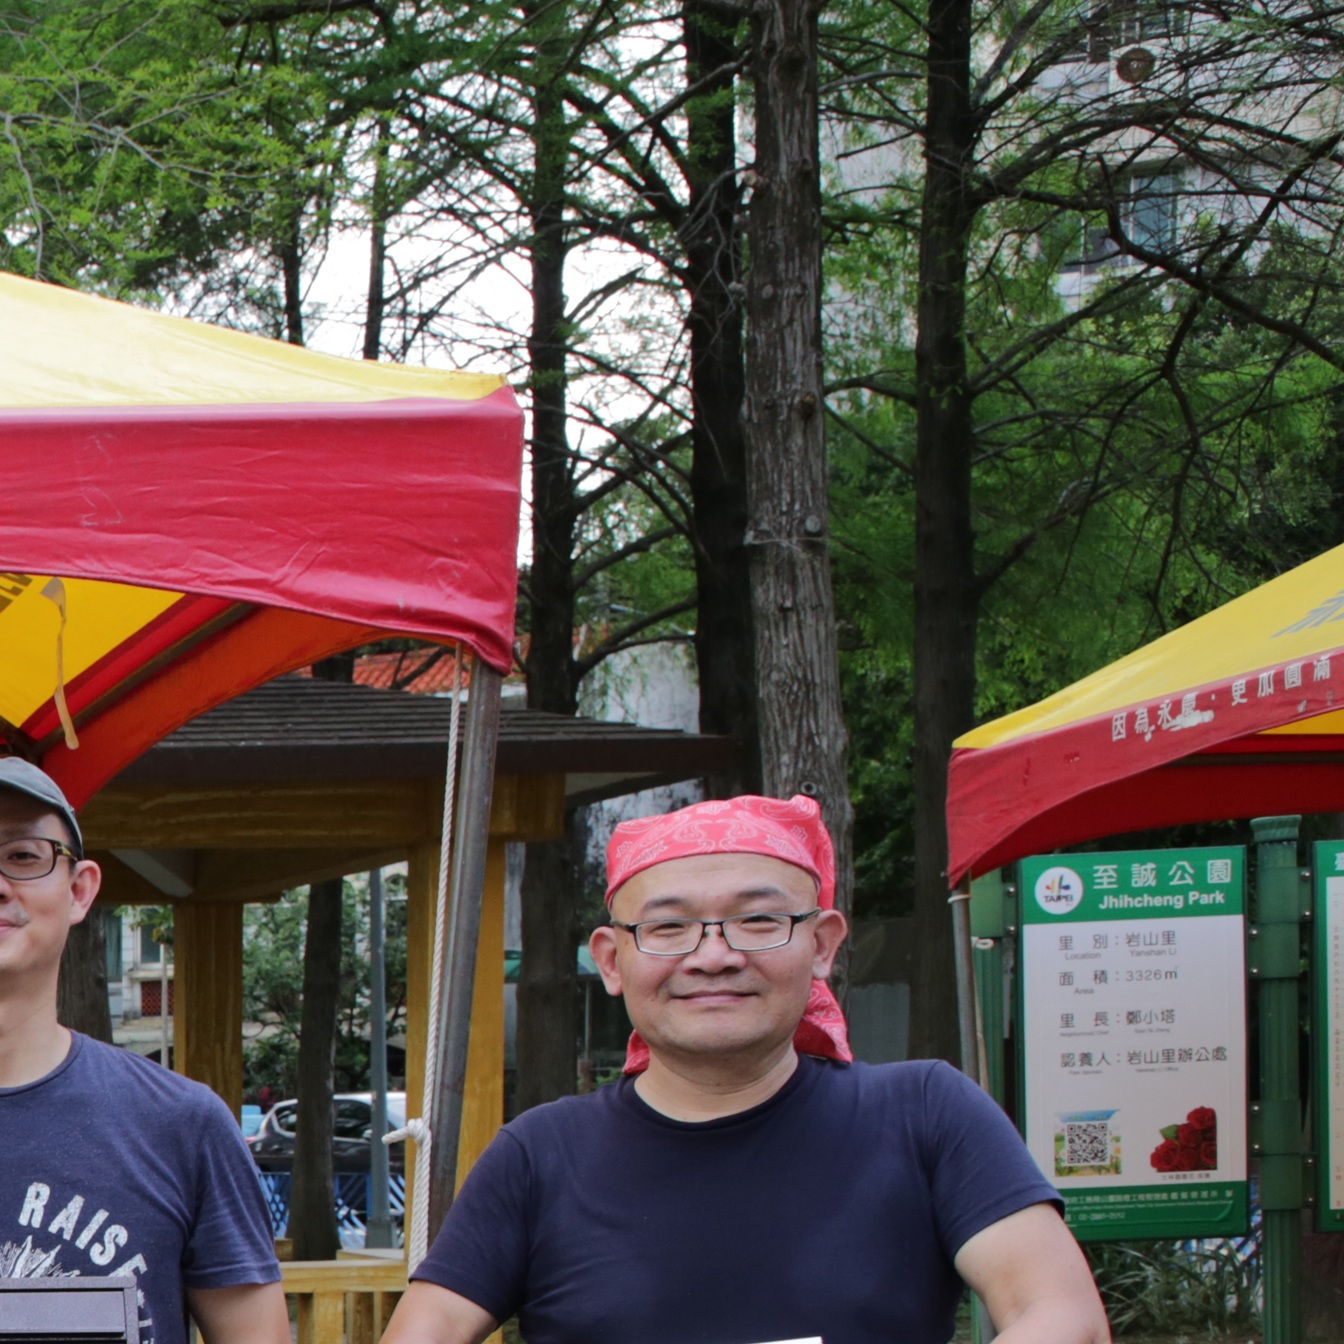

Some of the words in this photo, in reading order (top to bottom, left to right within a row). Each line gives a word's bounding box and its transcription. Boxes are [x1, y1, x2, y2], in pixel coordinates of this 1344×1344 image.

[1093, 859, 1231, 889] 至誠公園
[1099, 894, 1184, 909] Jhihcheng
[1188, 891, 1225, 905] Park
